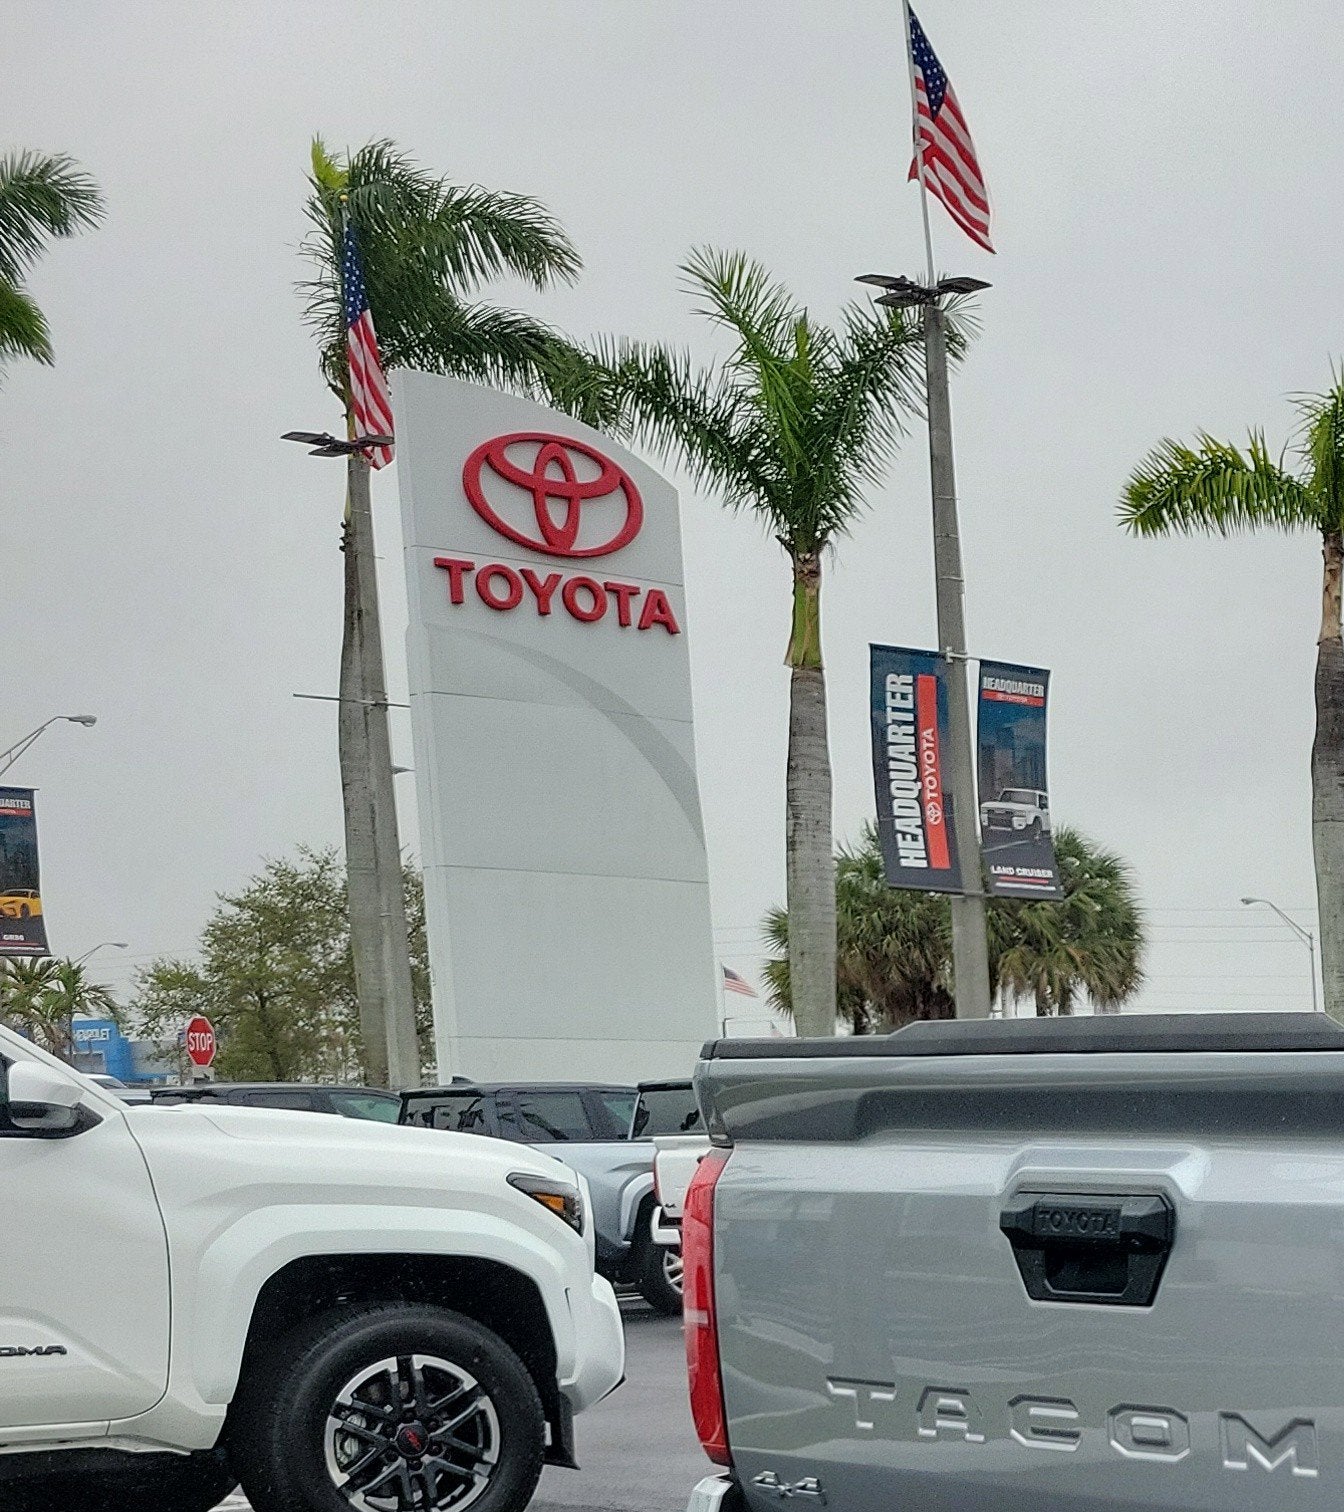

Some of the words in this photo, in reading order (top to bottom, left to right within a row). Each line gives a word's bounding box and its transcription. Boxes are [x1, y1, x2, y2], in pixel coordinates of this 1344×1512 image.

[434, 557, 681, 635] TOYOTA
[886, 673, 928, 869] HEADQUARTER
[919, 728, 940, 800] TOYOTA
[990, 865, 1014, 876] LAND
[188, 1032, 213, 1051] STOP
[1038, 1210, 1117, 1235] TOYOTA
